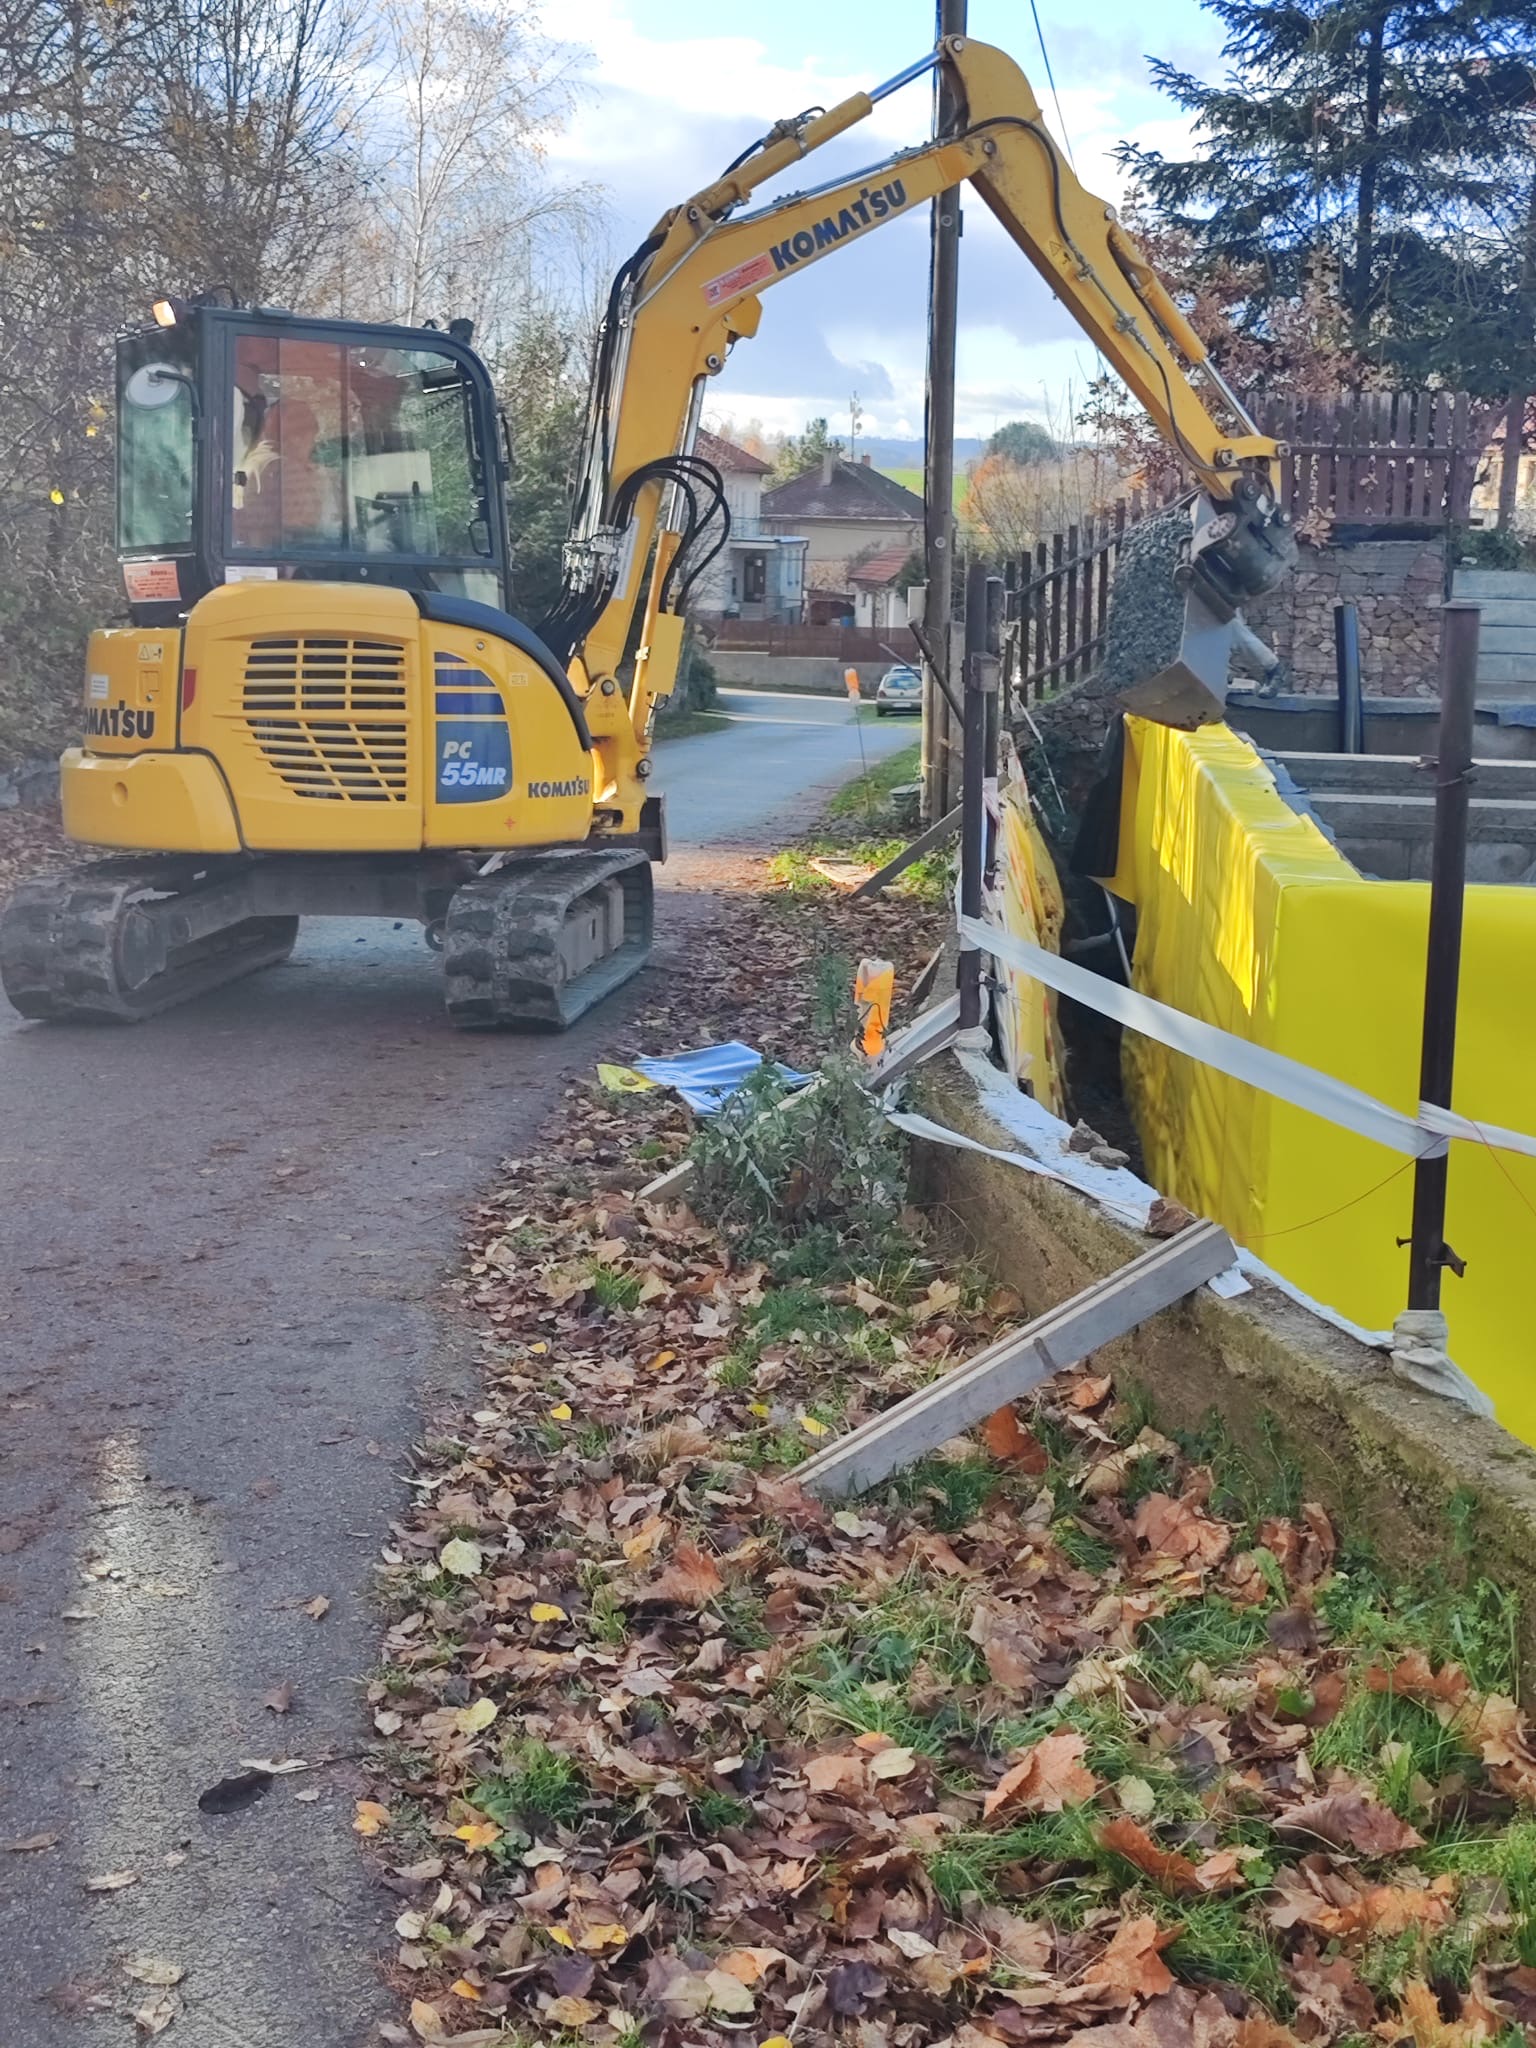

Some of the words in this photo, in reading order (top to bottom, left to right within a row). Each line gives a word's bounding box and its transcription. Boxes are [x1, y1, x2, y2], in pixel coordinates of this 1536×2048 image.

[769, 179, 907, 272] KOMATSU
[442, 741, 473, 759] PC
[440, 762, 507, 786] 55MR
[528, 776, 590, 799] KOMATSU
